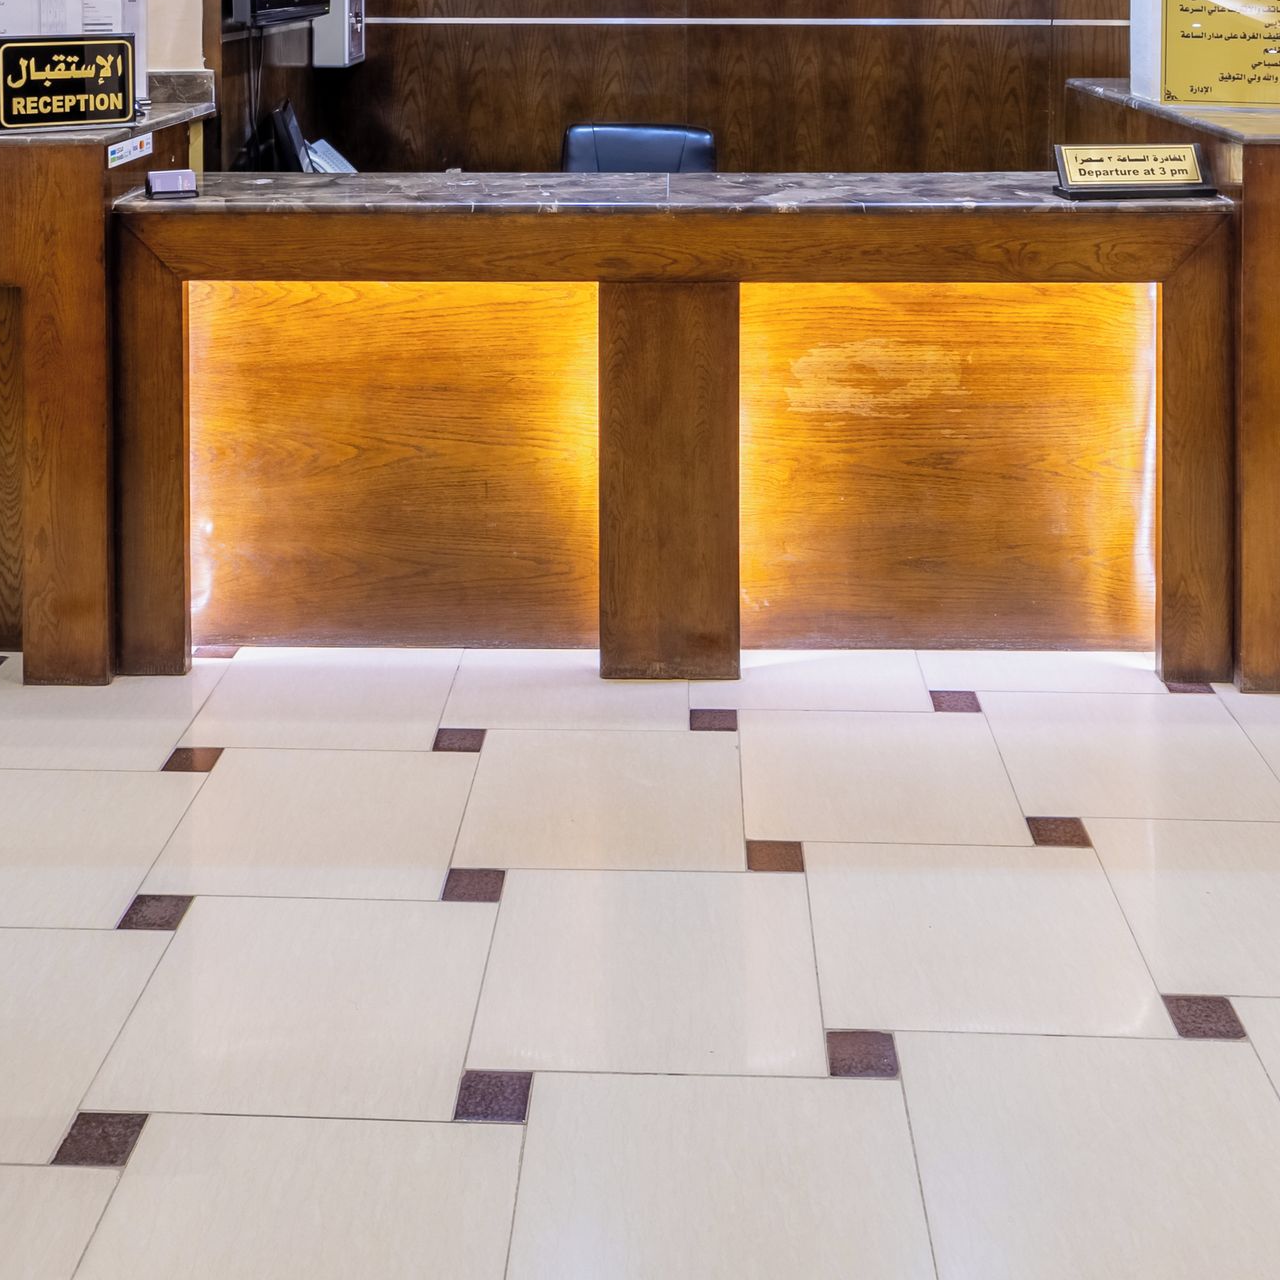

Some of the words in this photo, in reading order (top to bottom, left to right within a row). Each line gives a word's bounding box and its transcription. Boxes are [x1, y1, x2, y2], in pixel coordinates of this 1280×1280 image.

[1180, 5, 1206, 15] السرعة
[1208, 5, 1226, 15] عالي
[1181, 31, 1206, 39] الساعة
[1240, 33, 1261, 41] الغرف
[1218, 73, 1246, 83] التوفيق
[1248, 75, 1261, 84] ولي
[1264, 74, 1279, 83] والله
[12, 93, 123, 115] RECEPTION
[1117, 154, 1149, 162] الساعة
[1153, 154, 1186, 163] المغادرة
[1078, 168, 1140, 178] Departure
[1144, 167, 1156, 176] at
[1160, 167, 1166, 175] 3
[1170, 168, 1188, 177] pm
